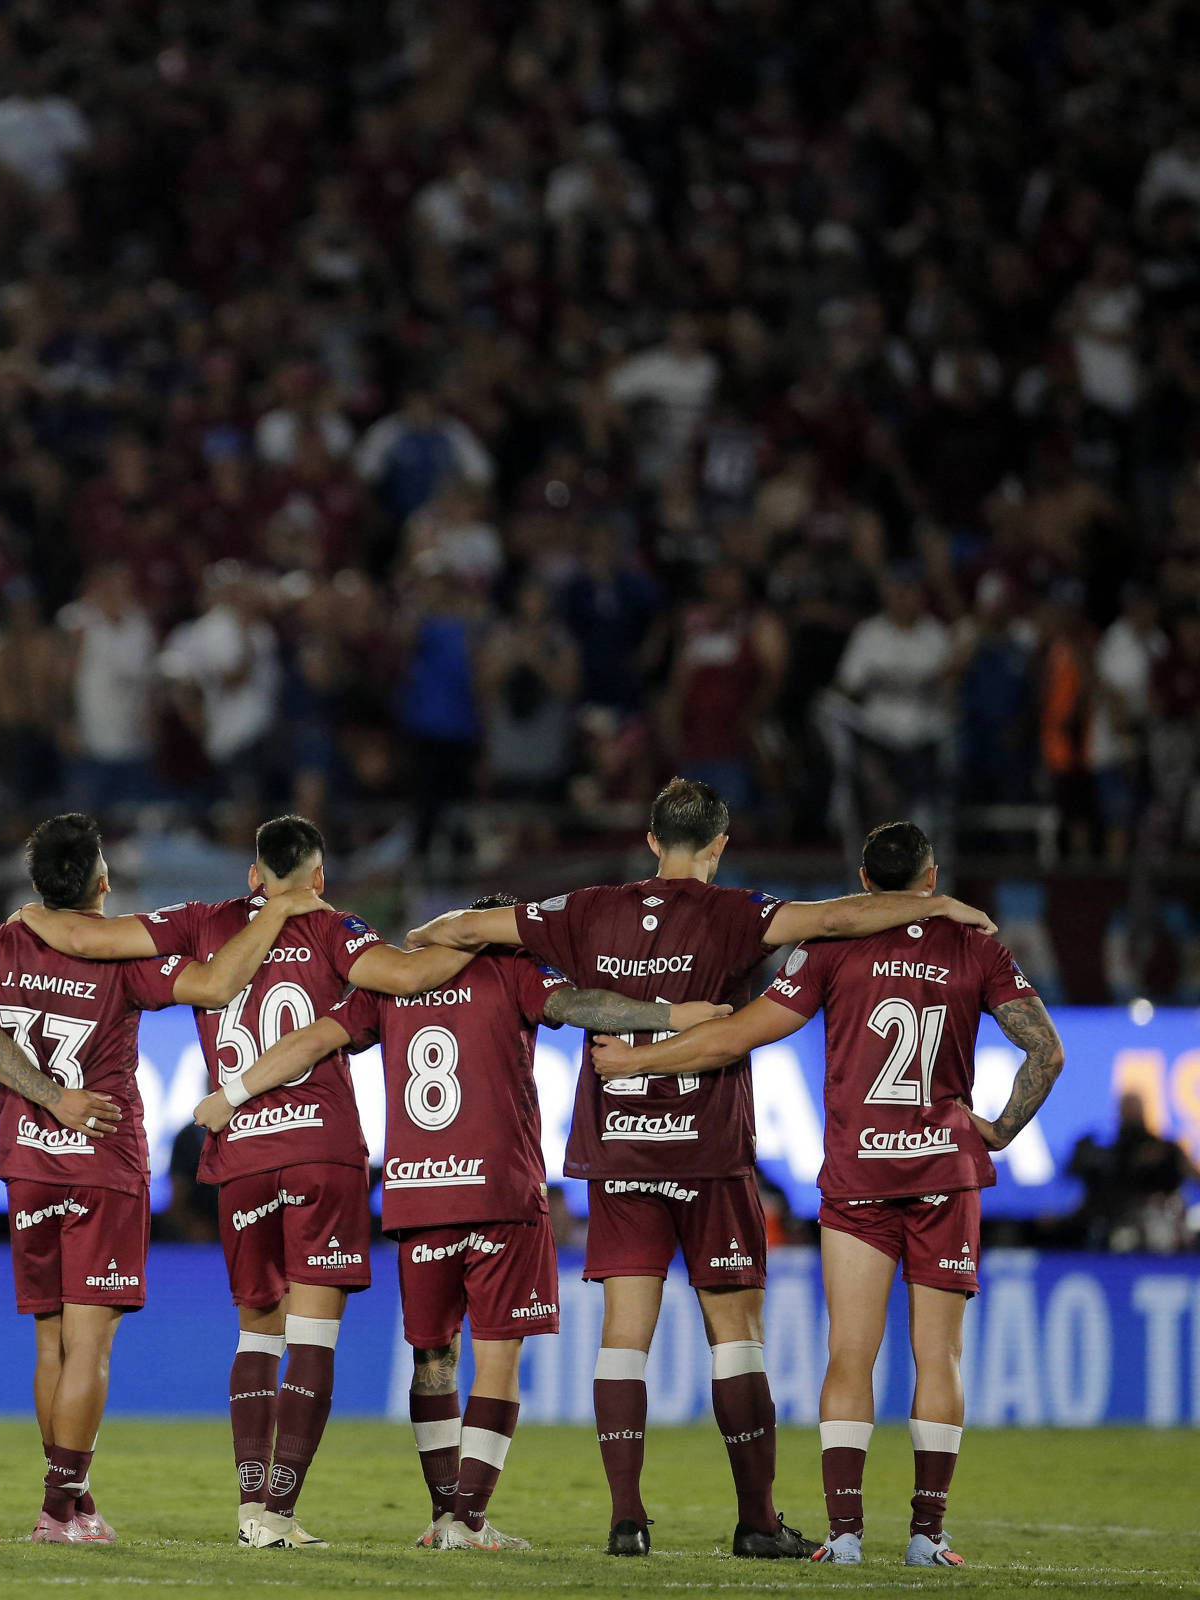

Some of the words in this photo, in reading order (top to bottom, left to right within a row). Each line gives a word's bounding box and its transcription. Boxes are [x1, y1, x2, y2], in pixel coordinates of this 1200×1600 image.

[596, 954, 694, 979] IZQUIERDOZ
[871, 960, 951, 985] MENDEZ
[0, 971, 16, 988] J.
[19, 973, 97, 1000] RAMIREZ
[395, 986, 472, 1008] WATSON
[206, 980, 317, 1088] 30
[863, 996, 948, 1108] 21
[404, 1025, 462, 1131] 8
[230, 1102, 320, 1132] CartaSur
[605, 1110, 696, 1133] CartaSur
[859, 1125, 952, 1150] CartaSur
[385, 1153, 484, 1180] CartaSur
[306, 1251, 363, 1266] andina
[710, 1253, 753, 1268] andina
[938, 1256, 977, 1272] andin
[85, 1272, 139, 1287] andina
[511, 1300, 557, 1319] andina
